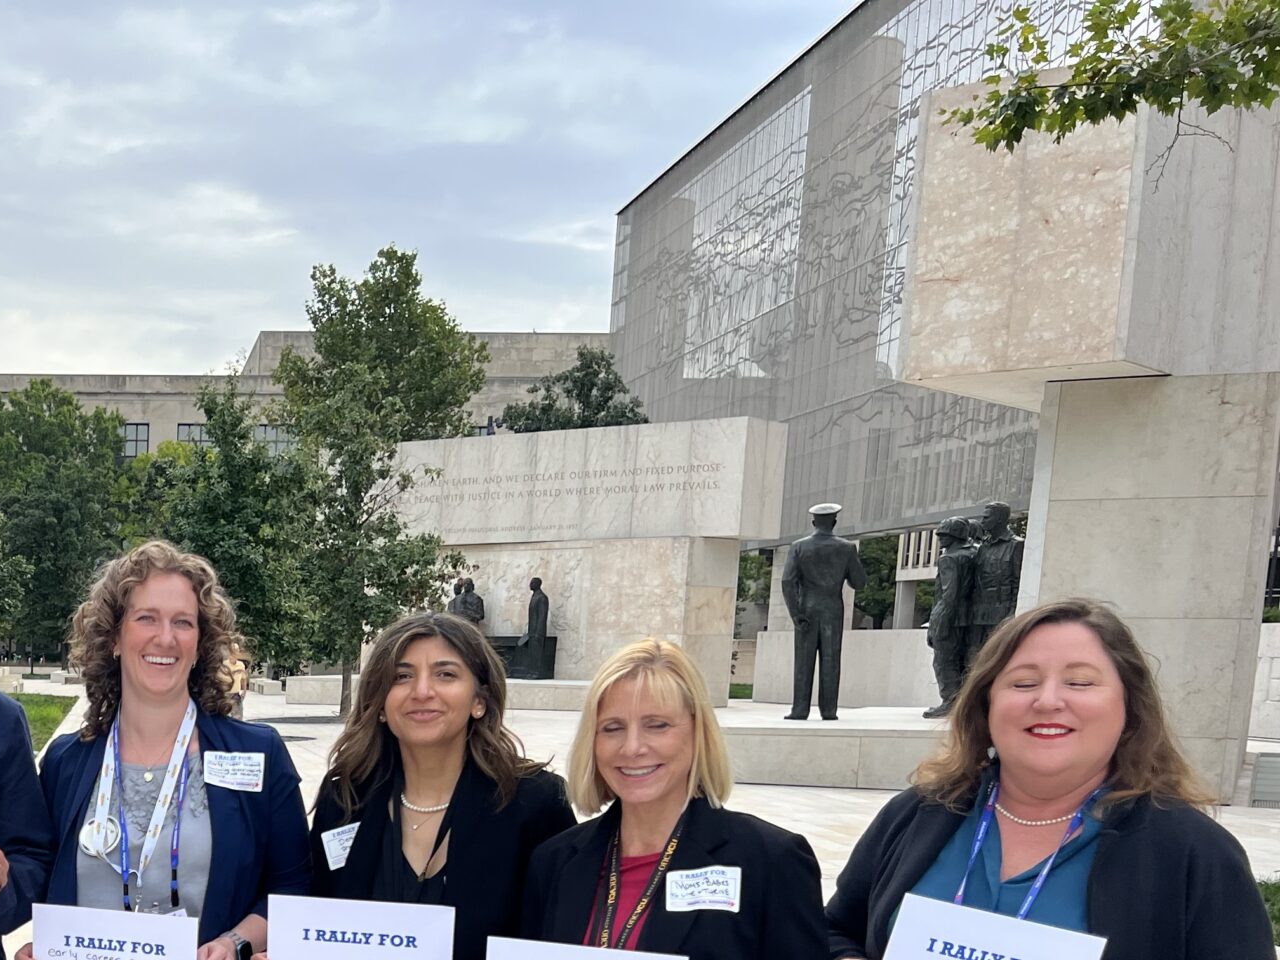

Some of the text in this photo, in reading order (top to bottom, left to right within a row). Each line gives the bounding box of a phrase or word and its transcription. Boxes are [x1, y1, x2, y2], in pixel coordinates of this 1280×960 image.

[483, 476, 502, 485] AND
[506, 474, 519, 483] WE
[523, 472, 565, 482] DECLARE
[570, 470, 590, 480] OUR
[594, 469, 617, 478] FIRM
[621, 467, 642, 477] AND
[646, 466, 674, 476] FIXED
[443, 493, 464, 502] WITH
[468, 491, 501, 501] JUSTICE
[505, 490, 514, 499] IN
[526, 488, 562, 498] WORLD
[566, 486, 601, 496] WHERE
[606, 484, 639, 494] MORAL
[644, 482, 666, 493] LAW
[64, 935, 166, 956] I RALLY FOR
[302, 928, 418, 948] I RALLY FOR
[926, 938, 938, 952] I
